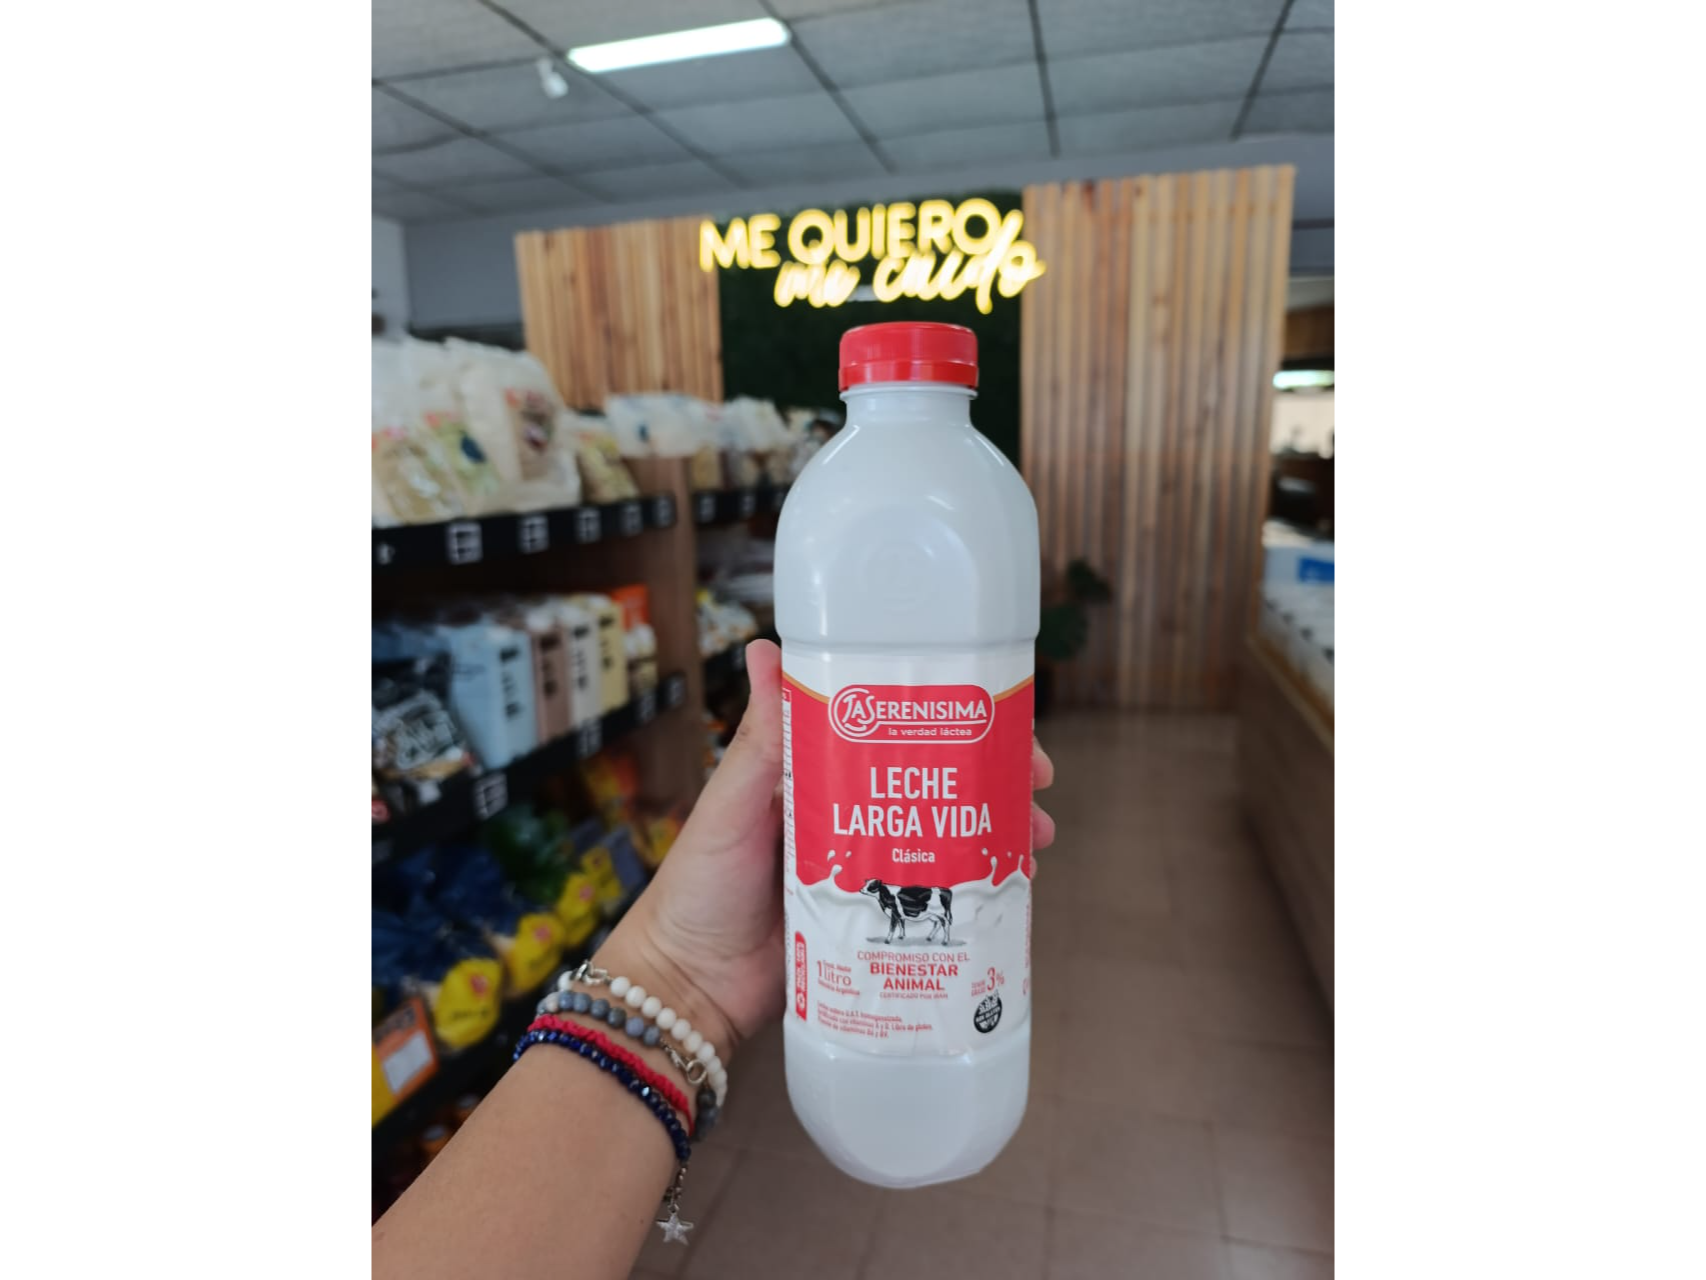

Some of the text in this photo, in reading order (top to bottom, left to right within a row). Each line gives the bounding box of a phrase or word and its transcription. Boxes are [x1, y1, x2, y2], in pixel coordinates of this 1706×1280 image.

[699, 197, 1003, 272] ME QUIERO
[888, 727, 972, 737] la verdad láctea
[870, 766, 958, 800] LECHE
[832, 803, 993, 838] LARGA VIDA
[891, 847, 936, 863] Clásica
[857, 950, 971, 963] COMPROMISO CON EL
[817, 960, 852, 986] 1 litro
[869, 962, 959, 977] BIENESTAR
[883, 977, 946, 991] ANIMAL
